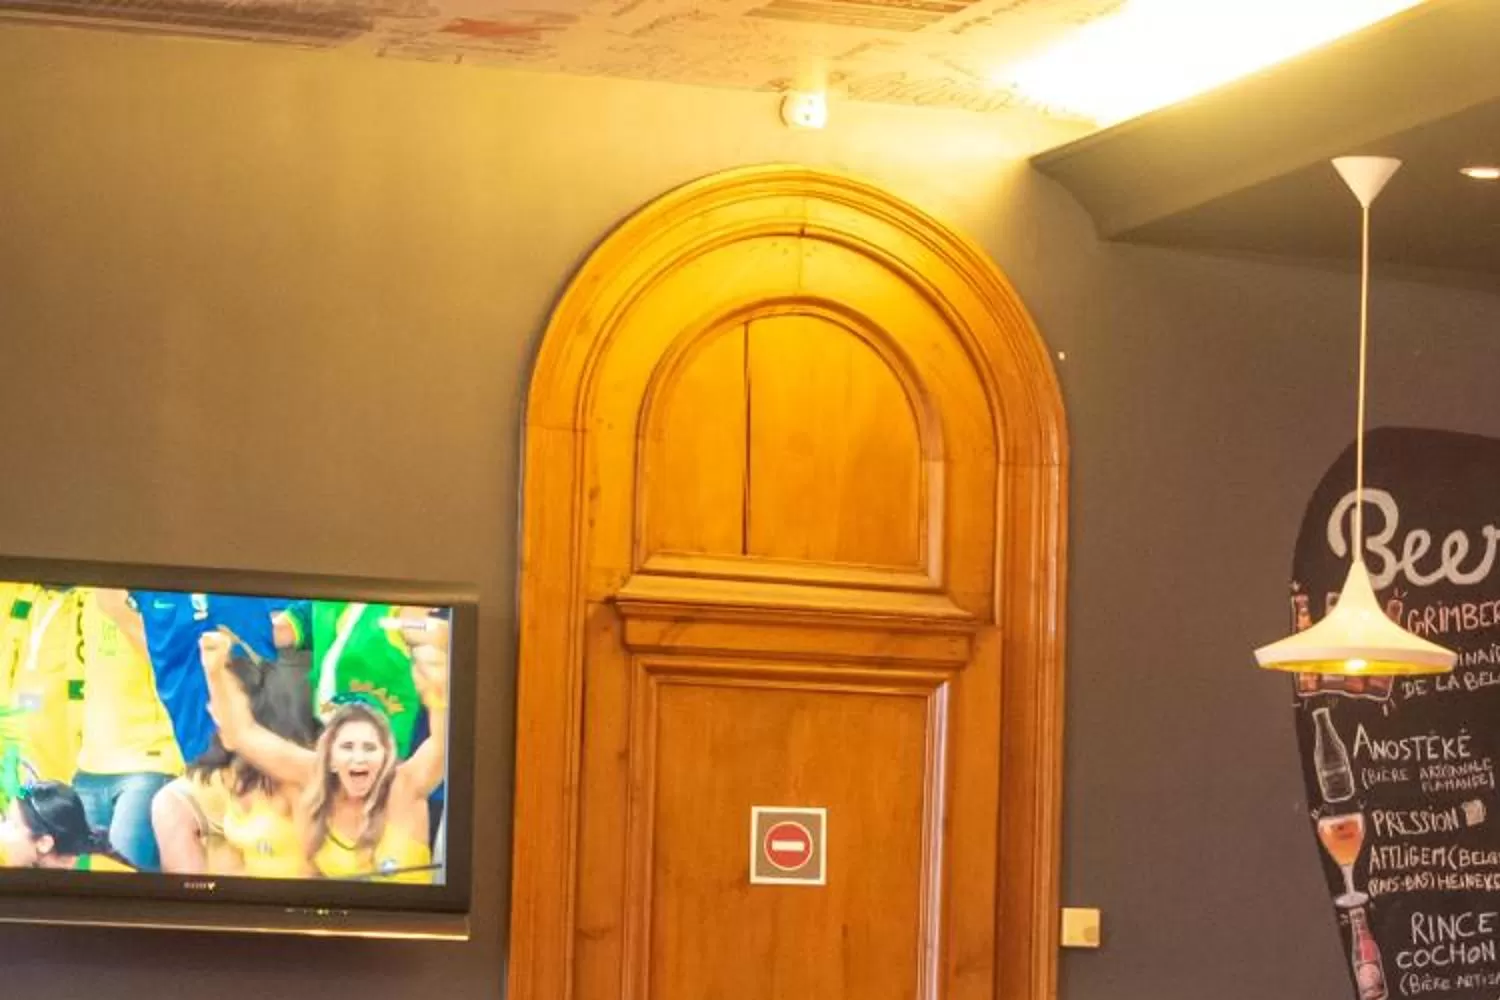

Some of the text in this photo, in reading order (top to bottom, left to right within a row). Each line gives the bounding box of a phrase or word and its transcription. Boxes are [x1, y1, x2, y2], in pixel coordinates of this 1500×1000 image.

[1402, 679, 1428, 700] DE
[1435, 675, 1460, 692] LA
[1371, 805, 1460, 838] PRESSION
[1410, 911, 1499, 945] RINCE
[1396, 939, 1496, 969] COCHON
